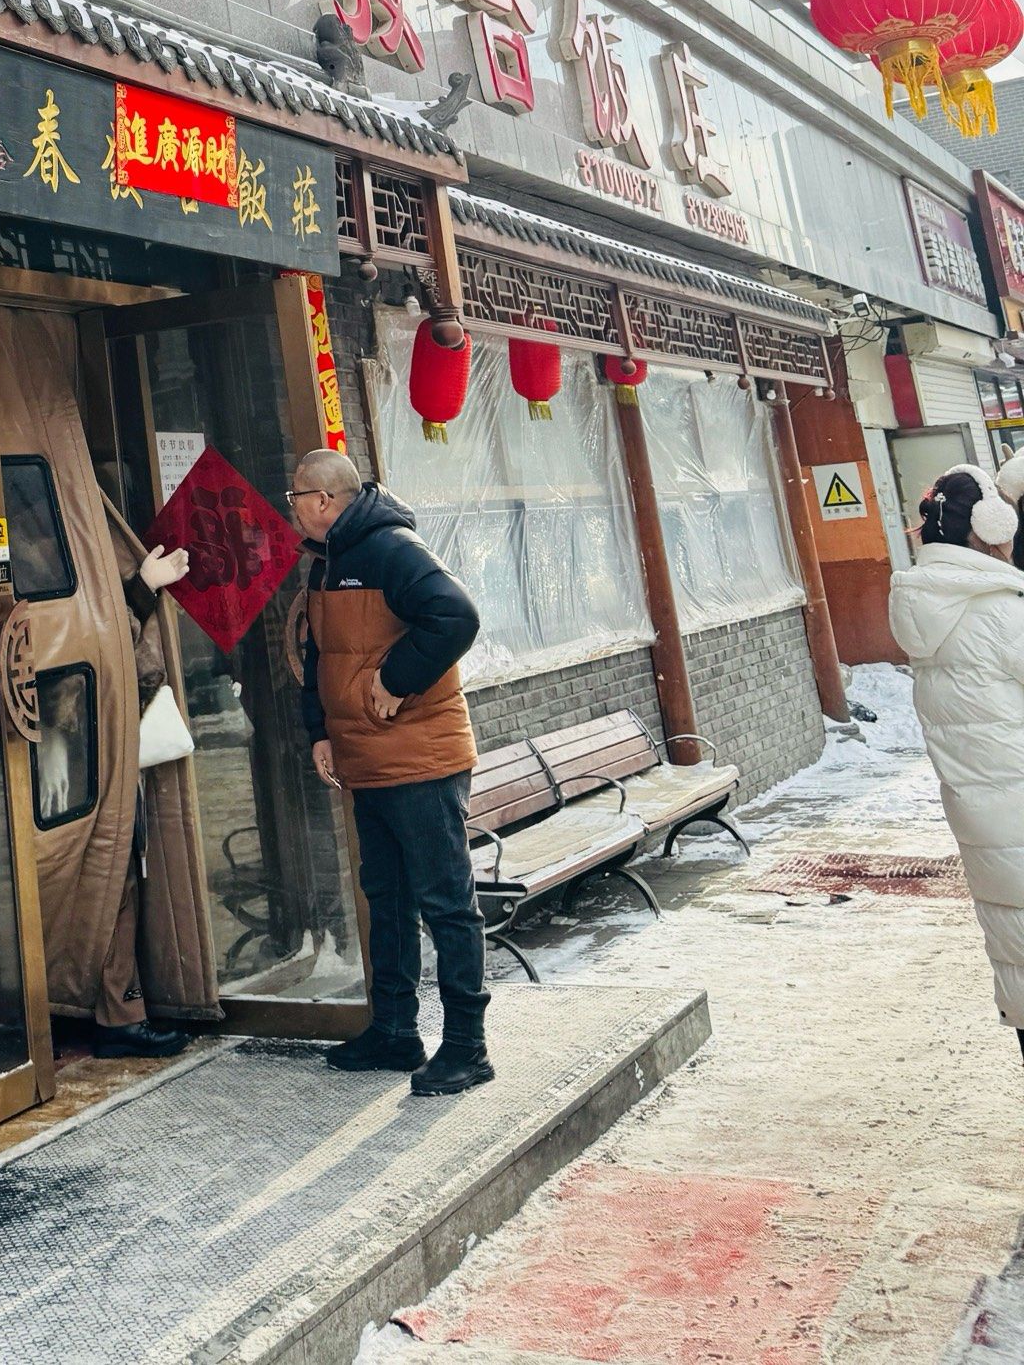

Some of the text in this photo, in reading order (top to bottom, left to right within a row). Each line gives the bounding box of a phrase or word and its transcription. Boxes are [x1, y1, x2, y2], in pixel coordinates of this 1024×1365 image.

[22, 87, 322, 243] 春飯莊
[577, 149, 662, 213] 81000872
